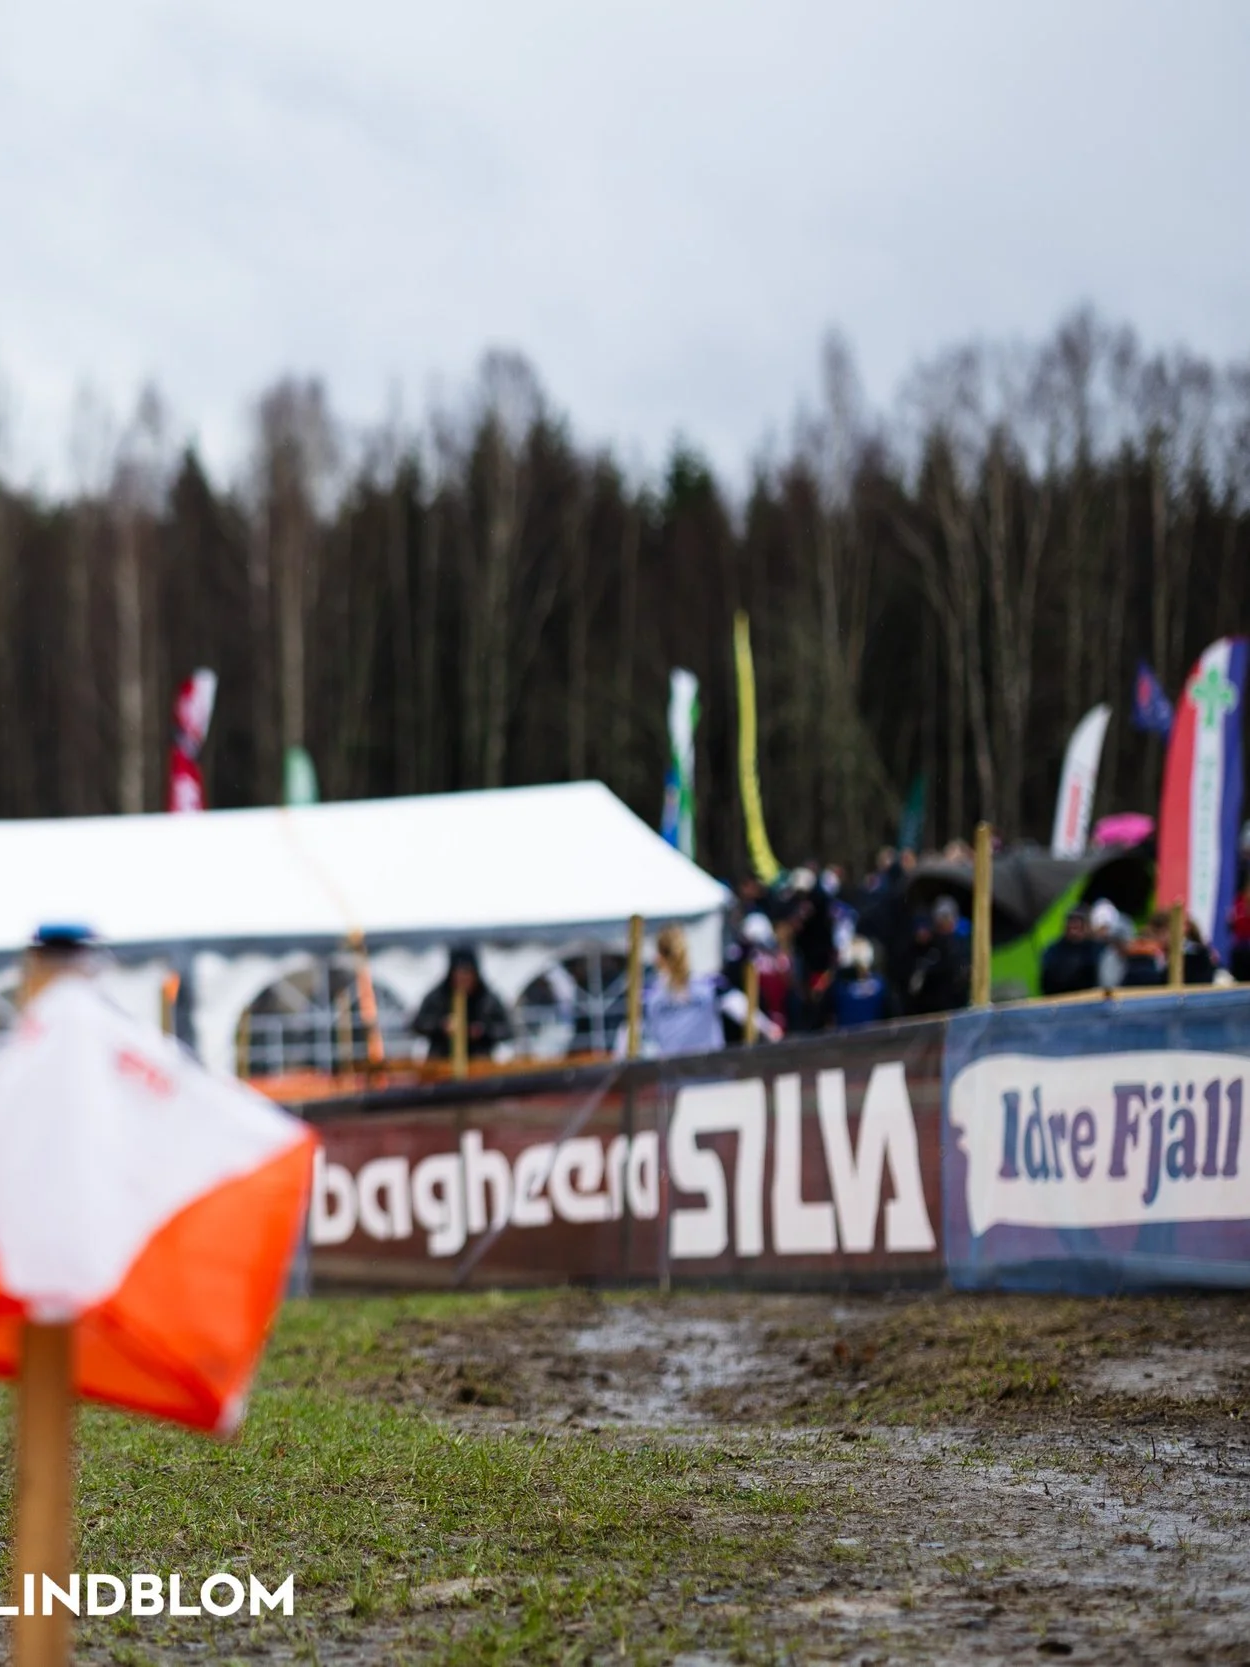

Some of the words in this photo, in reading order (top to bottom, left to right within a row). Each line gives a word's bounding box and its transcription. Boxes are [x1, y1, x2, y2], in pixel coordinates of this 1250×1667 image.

[311, 1129, 660, 1258] bagheera
[669, 1061, 937, 1260] SILVA
[997, 1083, 1097, 1181] Idre
[1107, 1075, 1244, 1207] Fjäll
